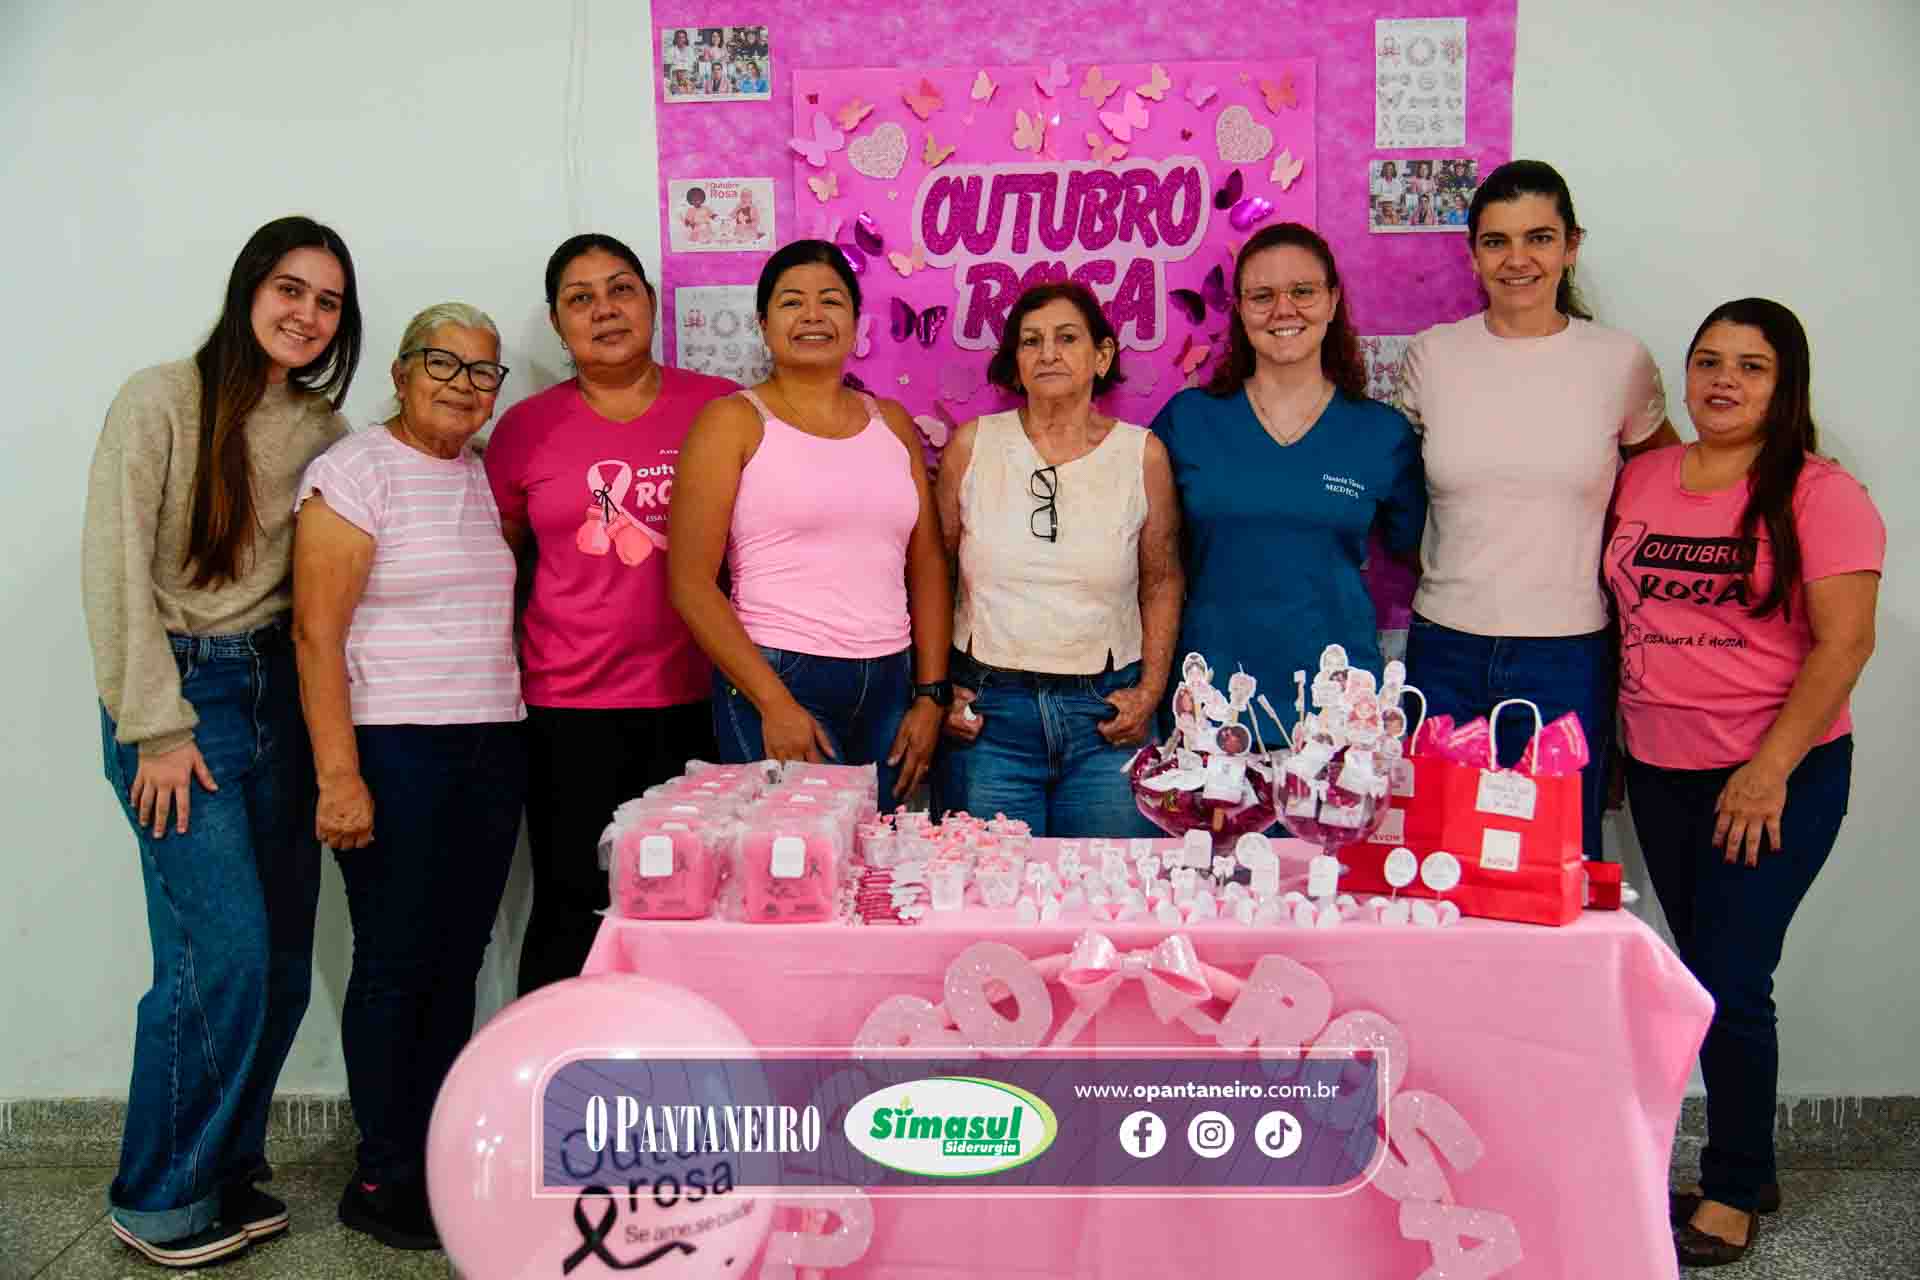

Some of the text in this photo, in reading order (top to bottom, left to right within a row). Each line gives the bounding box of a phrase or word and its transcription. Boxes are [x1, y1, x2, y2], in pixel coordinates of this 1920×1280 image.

[921, 166, 1202, 255] OUTUBRO
[1643, 541, 1737, 563] OUTUBR
[1640, 574, 1751, 607] ROSA
[628, 1161, 733, 1213] rosa
